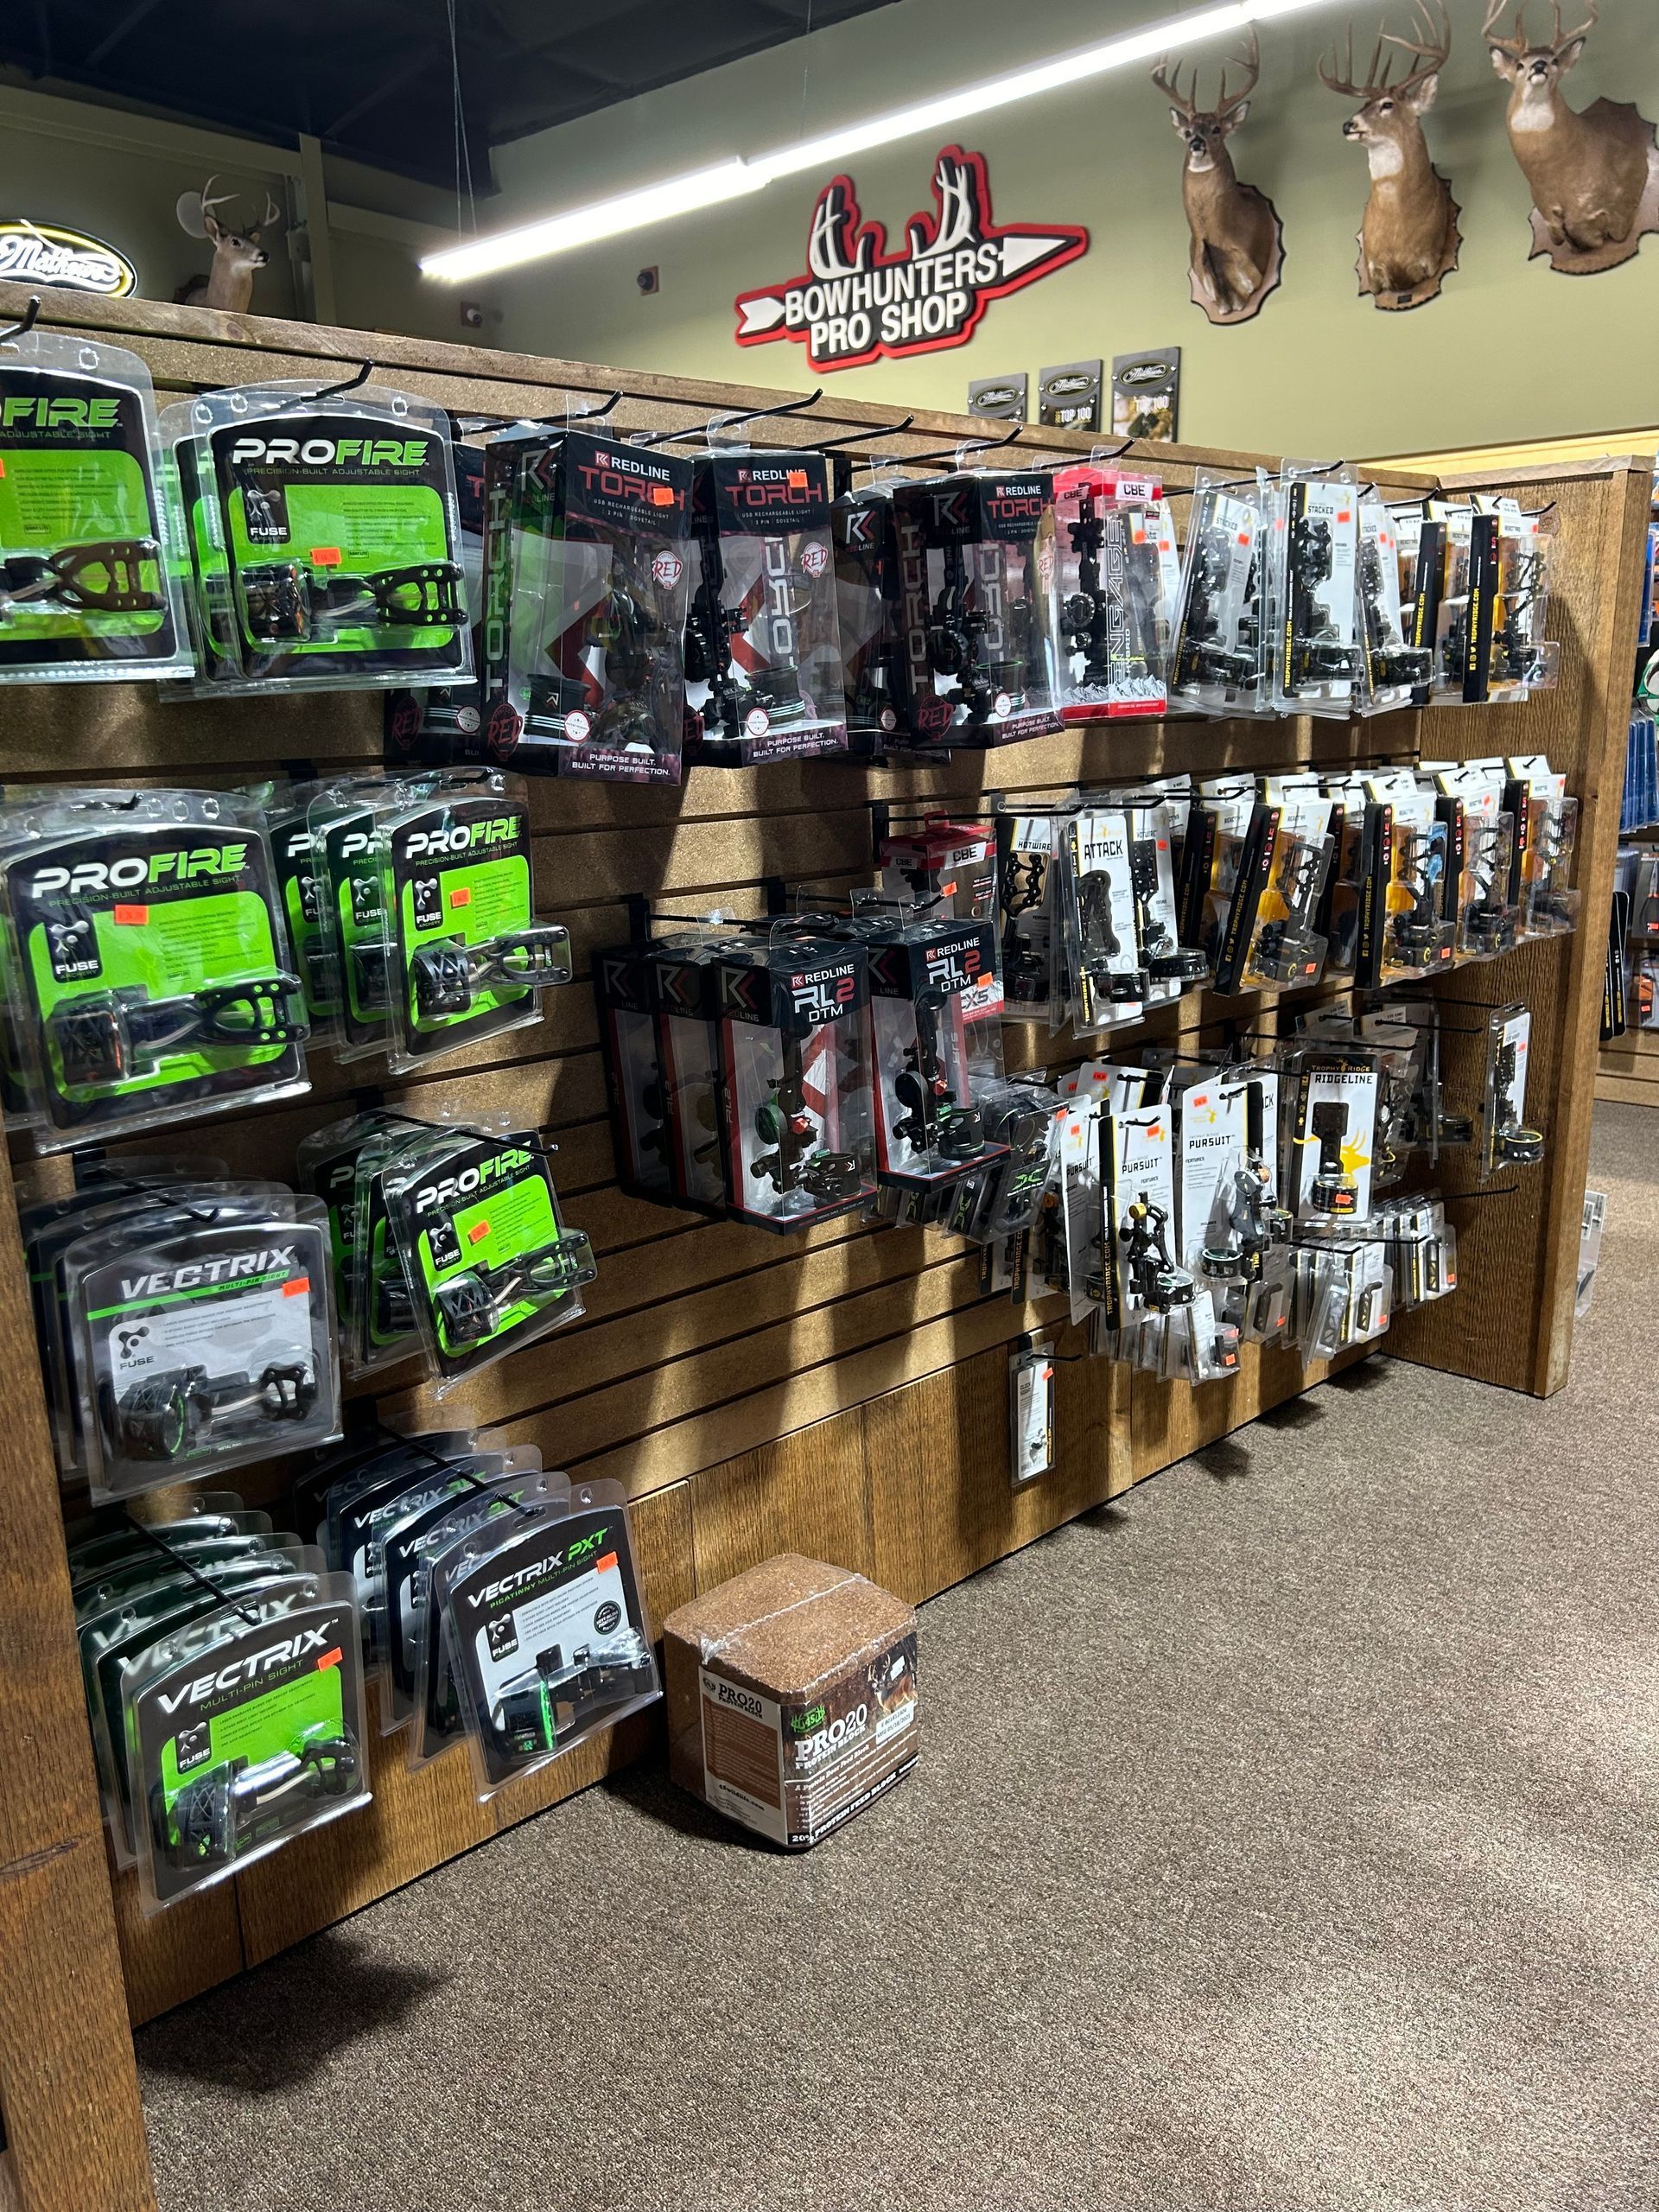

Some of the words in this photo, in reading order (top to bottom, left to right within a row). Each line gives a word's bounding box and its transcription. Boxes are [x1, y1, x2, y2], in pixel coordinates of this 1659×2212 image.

[785, 243, 999, 325] BOWHUNTERS
[810, 314, 870, 357] PRO
[881, 291, 968, 344] SHOP
[0, 397, 121, 428] FIRE
[1061, 410, 1076, 423] TOP
[1077, 407, 1093, 420] 100
[232, 438, 429, 466] PROFIRE
[611, 456, 671, 481] REDLINE
[753, 468, 805, 481] REDLI
[724, 482, 823, 507] TORCH
[1006, 486, 1042, 496] REDLINE
[1064, 490, 1084, 500] CBE
[1123, 484, 1146, 497] CBE
[607, 500, 652, 516] RECHARGEABLE
[1307, 505, 1334, 515] STACKED
[630, 514, 658, 526] DOVETAIL
[251, 527, 288, 537] FUSE
[486, 490, 509, 702] TORCH
[901, 524, 930, 696] TORCH
[1414, 593, 1426, 647] TROPHYRIDGE.COM
[1471, 588, 1480, 644] TROPHYRIDGE.COM
[1283, 621, 1293, 689] TROPHYRIDGE.COM
[753, 748, 774, 758] BUILT
[793, 739, 839, 752] PERFECTION.
[767, 736, 802, 747] PURPOSE
[572, 761, 598, 772] BUILT
[600, 764, 617, 772] FOR
[619, 766, 671, 777] PERFECTION.
[589, 753, 630, 765] PURPOSE
[404, 816, 523, 860] PROFIRE
[1018, 840, 1052, 851] HOTWIRE
[416, 852, 467, 867] PRECISION-BUILT
[467, 844, 501, 858] ADJUSTABLE
[501, 841, 518, 850] SIGHT
[952, 846, 978, 862] CBE
[1084, 840, 1123, 860] ATTACK
[32, 843, 248, 899] PROFIRE
[48, 888, 142, 908] PRECISION-BUILT
[145, 880, 210, 895] ADJUSTABLE
[213, 874, 241, 886] SIGHT
[355, 908, 383, 920] FUSE
[1230, 879, 1248, 936] TROPHYRIDGE.COM
[1363, 876, 1372, 930] TROPHYRIDGE.COM
[416, 912, 442, 922] FUSE
[937, 938, 981, 957] REDLINE
[55, 959, 99, 976] FUSE
[804, 963, 855, 985] REDLINE
[941, 975, 972, 993] DTM
[809, 1004, 844, 1023] DTM
[1315, 1074, 1374, 1084] RIDGELINE
[1189, 1135, 1231, 1149] PURSUIT
[1066, 1158, 1093, 1178] PURSUIT
[1122, 1158, 1159, 1174] PURSUIT
[416, 1141, 532, 1214] PROFIRE
[435, 1249, 461, 1266] FUSE
[121, 1245, 296, 1300] VECTRIX
[1103, 1241, 1113, 1316] TROPHYRIDGE.COM
[119, 1355, 155, 1370] FUSE
[467, 1550, 564, 1609] VECTRIX
[567, 1527, 609, 1561] PXT
[490, 1582, 537, 1610] PICATINNY
[537, 1562, 575, 1586] MULTI-PIN
[576, 1551, 598, 1566] SIGHT
[492, 1638, 518, 1659] FUSE
[158, 1622, 332, 1713] VECTRIX
[200, 1677, 264, 1712] MULTI-PIN
[268, 1659, 304, 1681] SIGHT
[718, 1683, 762, 1713] PRO20
[794, 1703, 868, 1762] PRO20
[180, 1747, 210, 1769] FUSE
[795, 1745, 837, 1770] PROTEIN
[837, 1726, 867, 1749] BLOCK
[815, 1806, 850, 1837] PROTEIN
[871, 1772, 897, 1796] BLOCK
